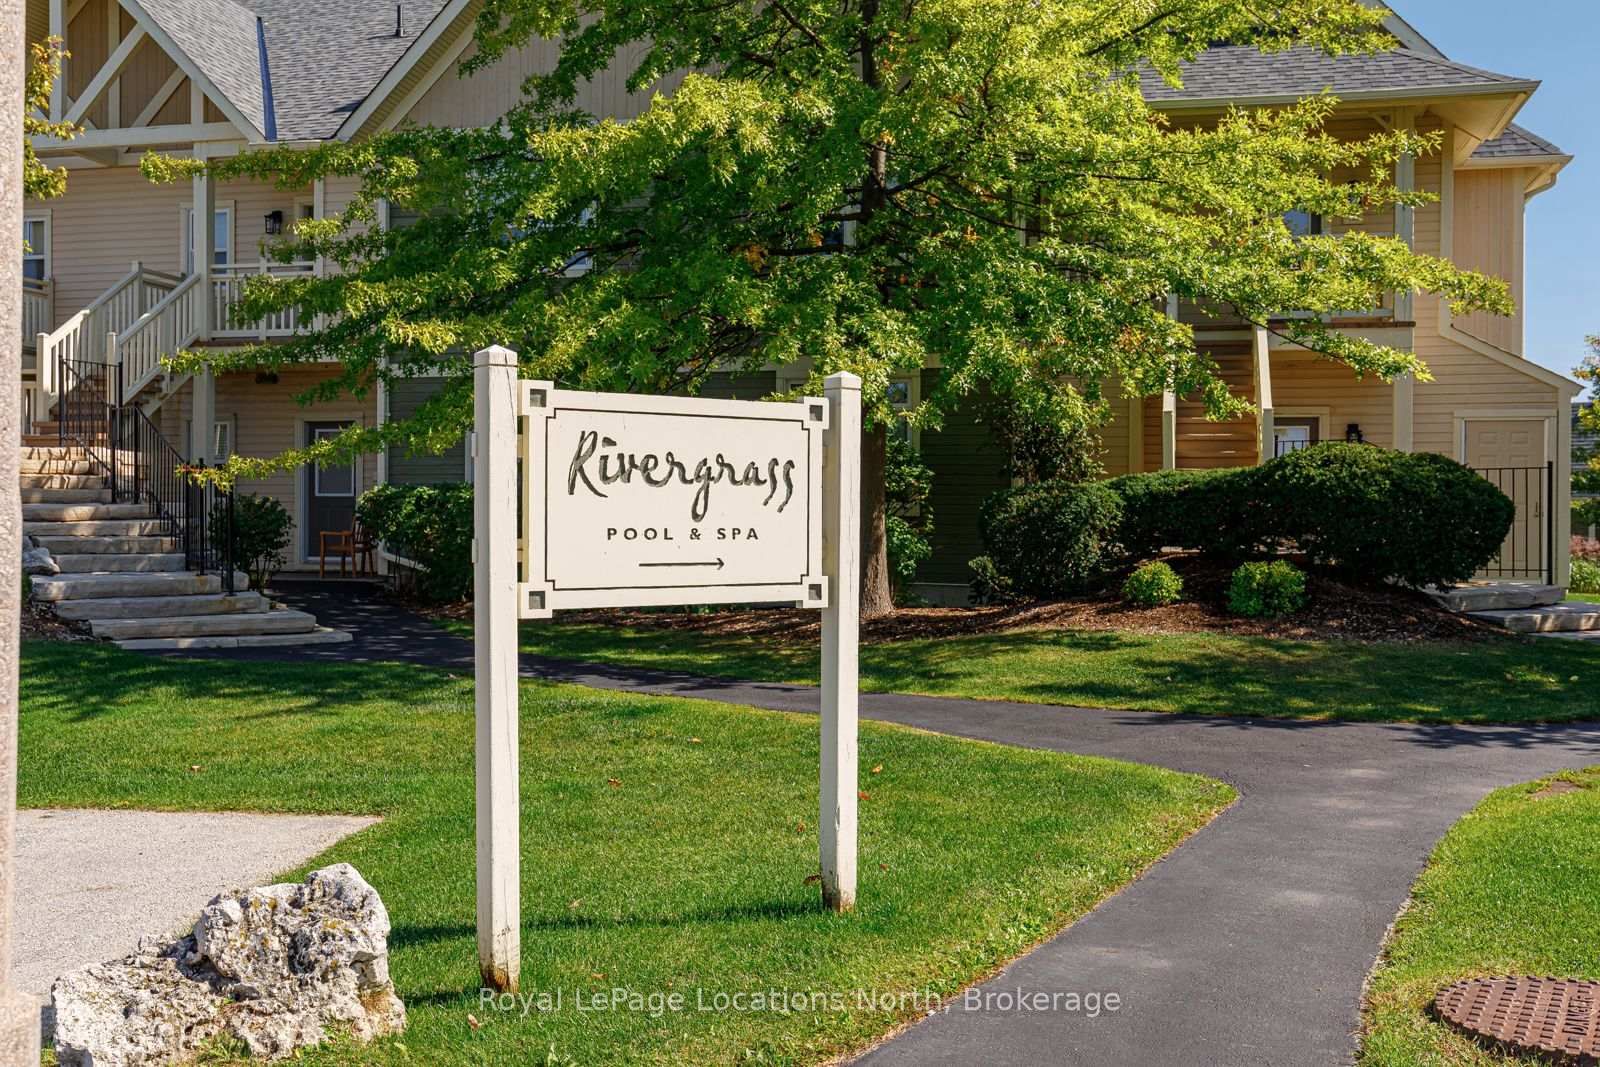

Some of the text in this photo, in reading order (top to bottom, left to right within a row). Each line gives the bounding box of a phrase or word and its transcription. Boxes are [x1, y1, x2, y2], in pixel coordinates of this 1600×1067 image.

[567, 429, 796, 523] Rivergrass
[606, 527, 760, 541] POOL & SPA
